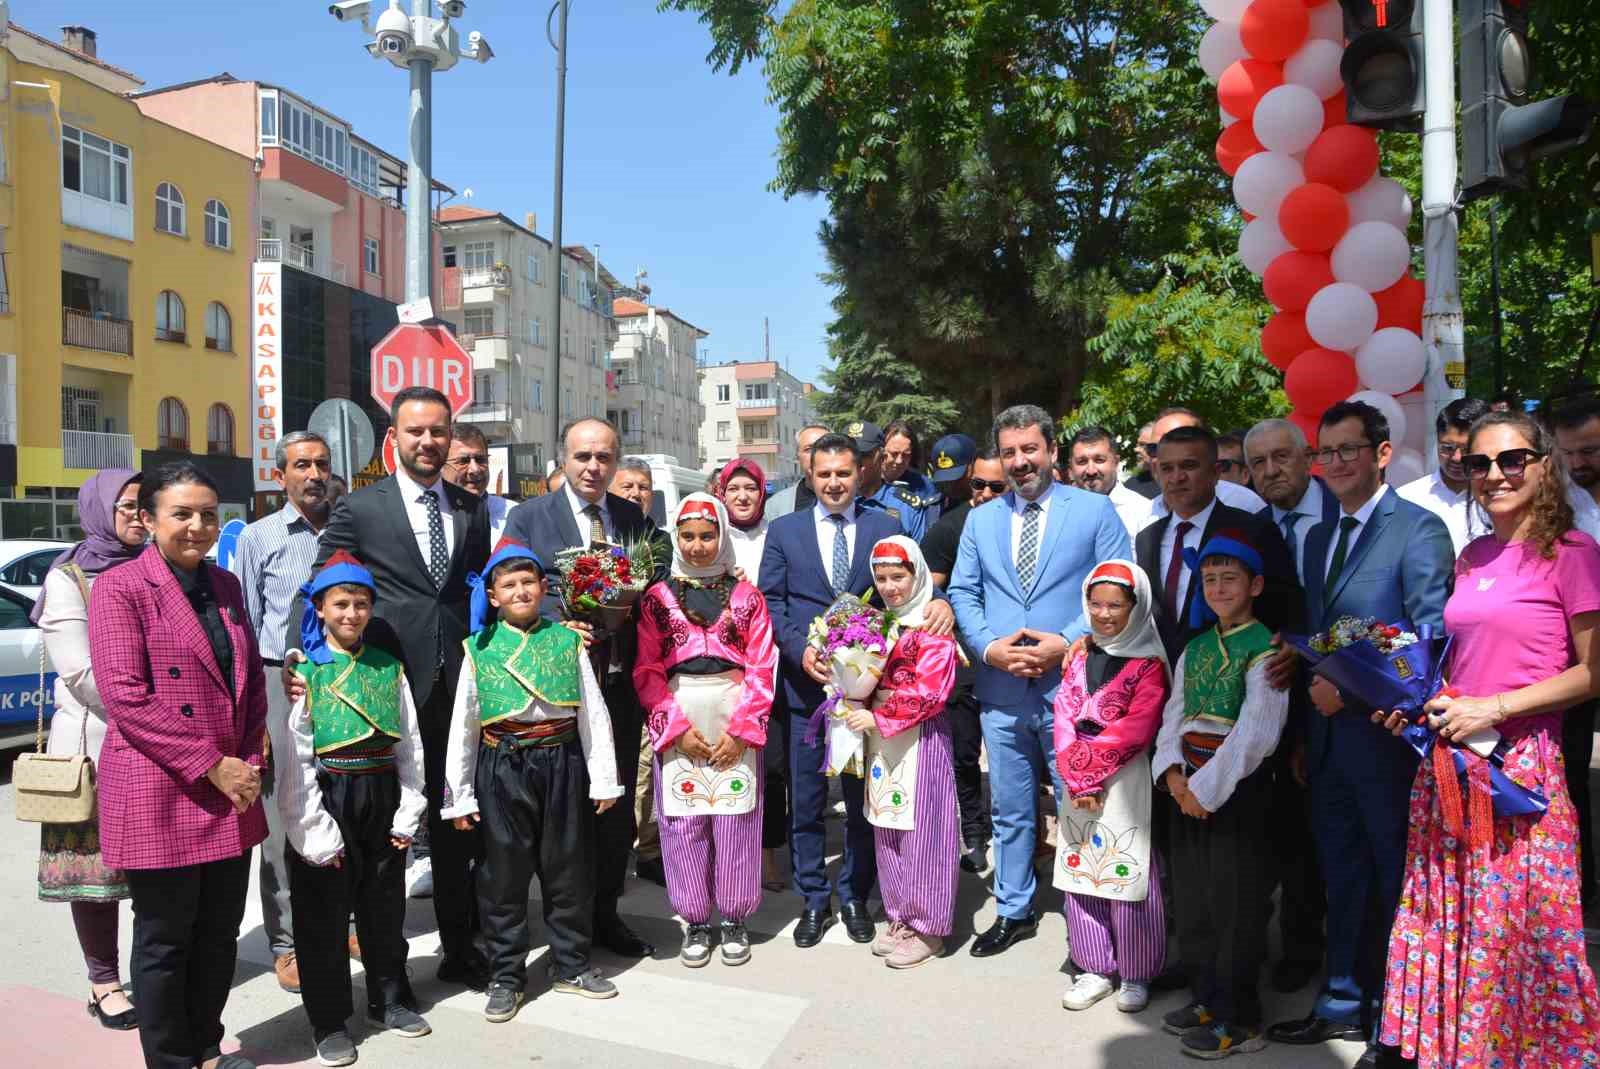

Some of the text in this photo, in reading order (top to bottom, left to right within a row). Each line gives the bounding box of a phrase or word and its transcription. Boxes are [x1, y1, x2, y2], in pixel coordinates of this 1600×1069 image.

[383, 355, 464, 396] DUR
[0, 690, 53, 710] K POL
